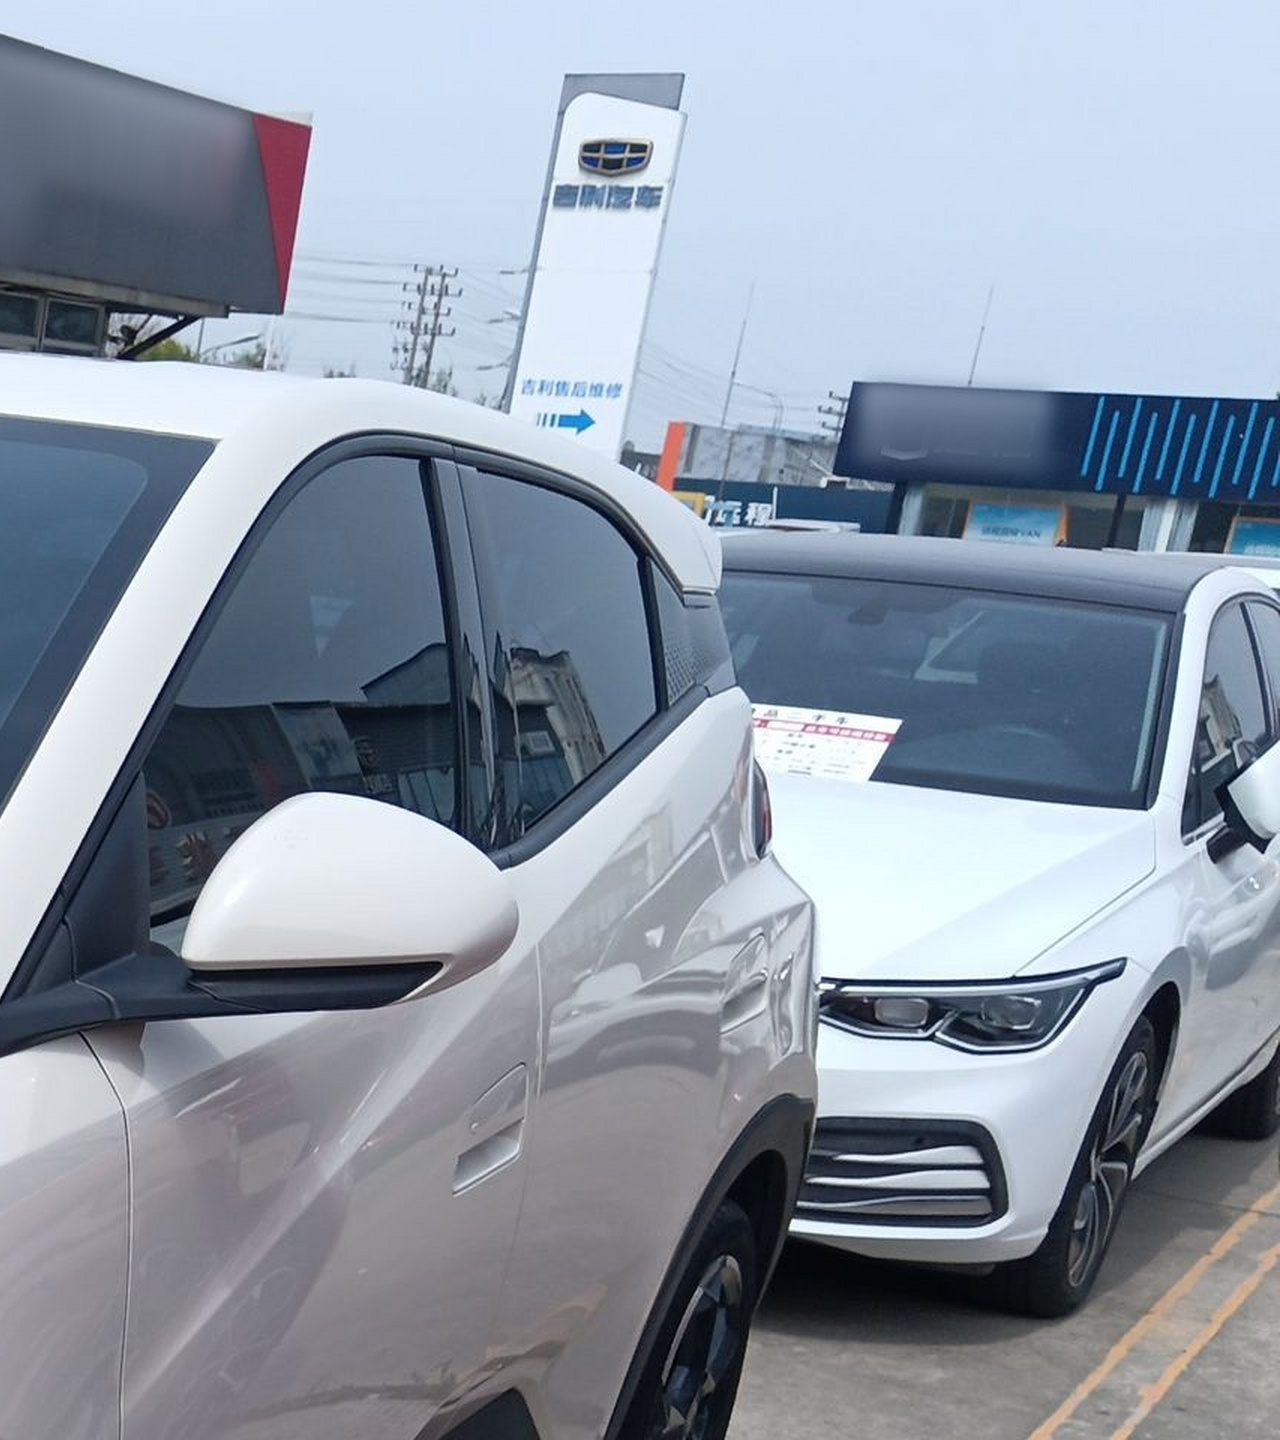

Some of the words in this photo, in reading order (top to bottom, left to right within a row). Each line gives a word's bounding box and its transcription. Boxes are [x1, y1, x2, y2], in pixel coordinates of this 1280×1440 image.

[552, 184, 664, 212] 吉利汽车
[521, 378, 623, 399] 吉利售后维修
